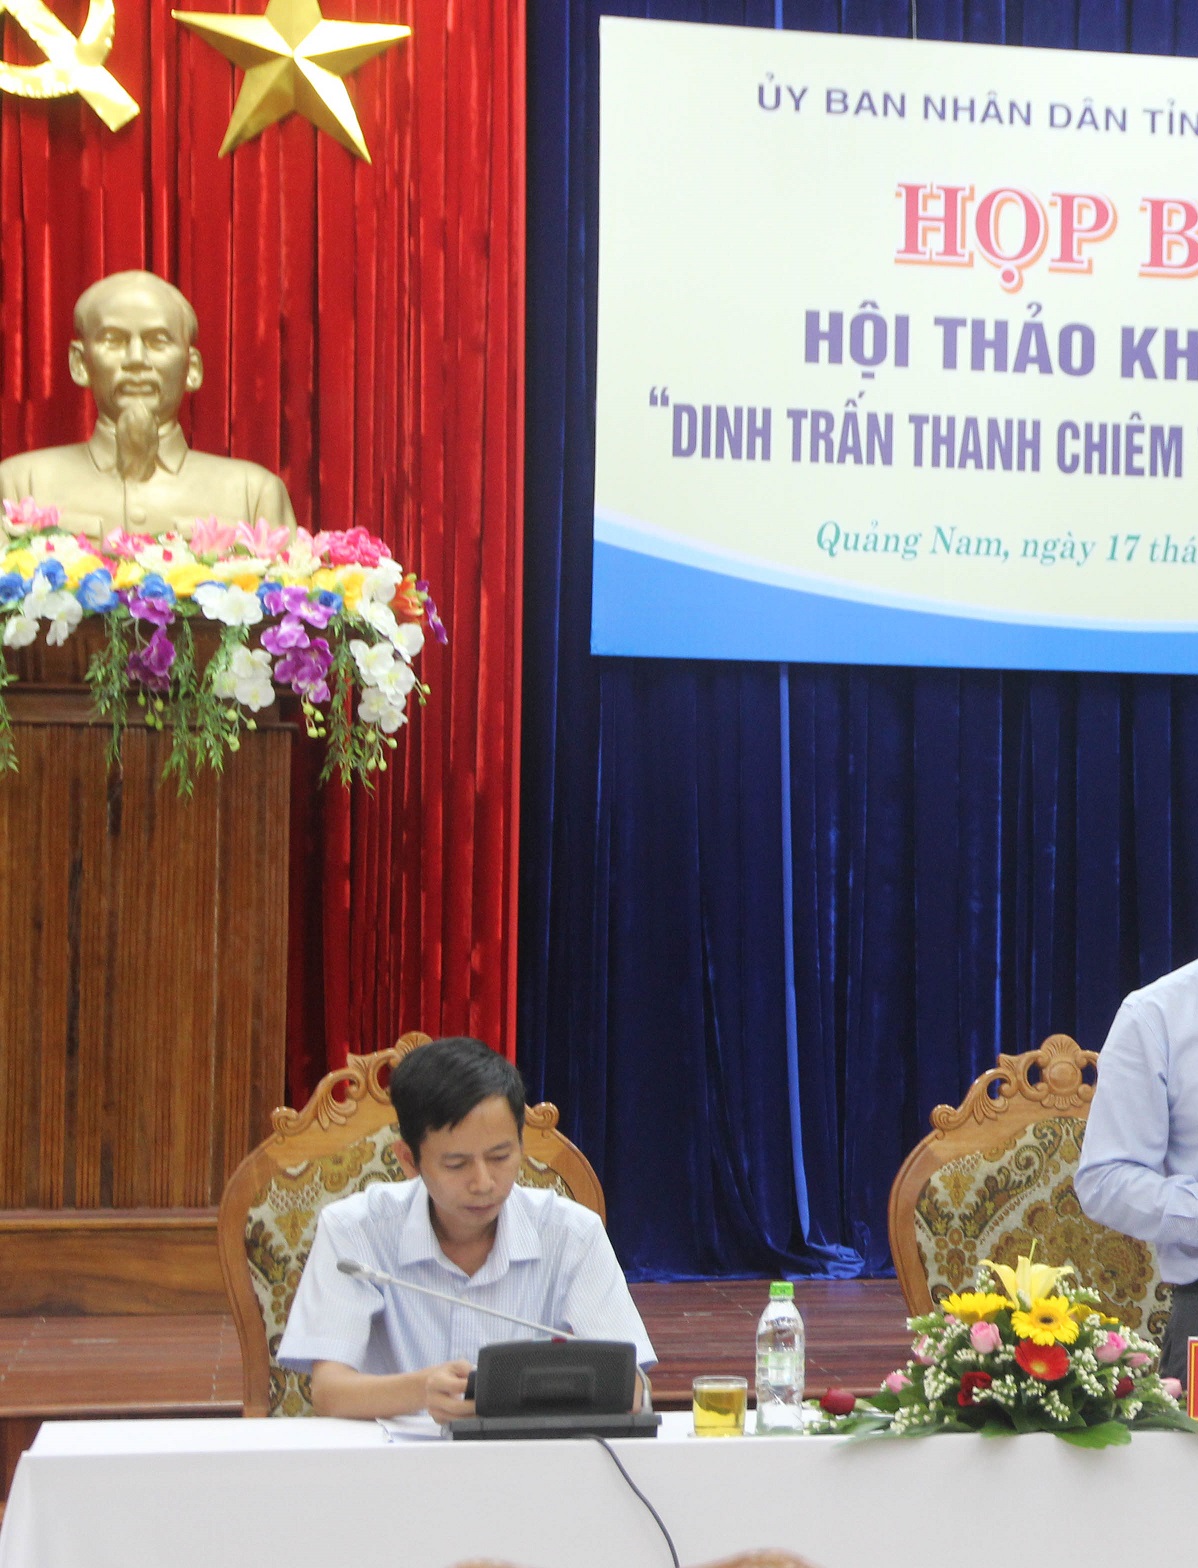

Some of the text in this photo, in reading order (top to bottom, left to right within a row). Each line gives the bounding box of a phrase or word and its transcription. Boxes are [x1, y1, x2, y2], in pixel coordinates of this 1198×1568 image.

[757, 73, 808, 113] ỦY
[825, 88, 906, 119] BAN
[923, 91, 1032, 127] NHÂN
[1049, 97, 1127, 133] DÂN
[893, 183, 1119, 295] HỌP
[804, 299, 910, 380] HỘI
[933, 302, 1096, 378] THẢO
[786, 391, 894, 467] TRẤN
[908, 413, 1041, 473] THANH
[1056, 411, 1184, 479] CHIÊM
[816, 522, 919, 558] Quảng
[930, 526, 1010, 560] Nam,
[1021, 531, 1096, 567] ngày
[1107, 534, 1141, 562] 17
